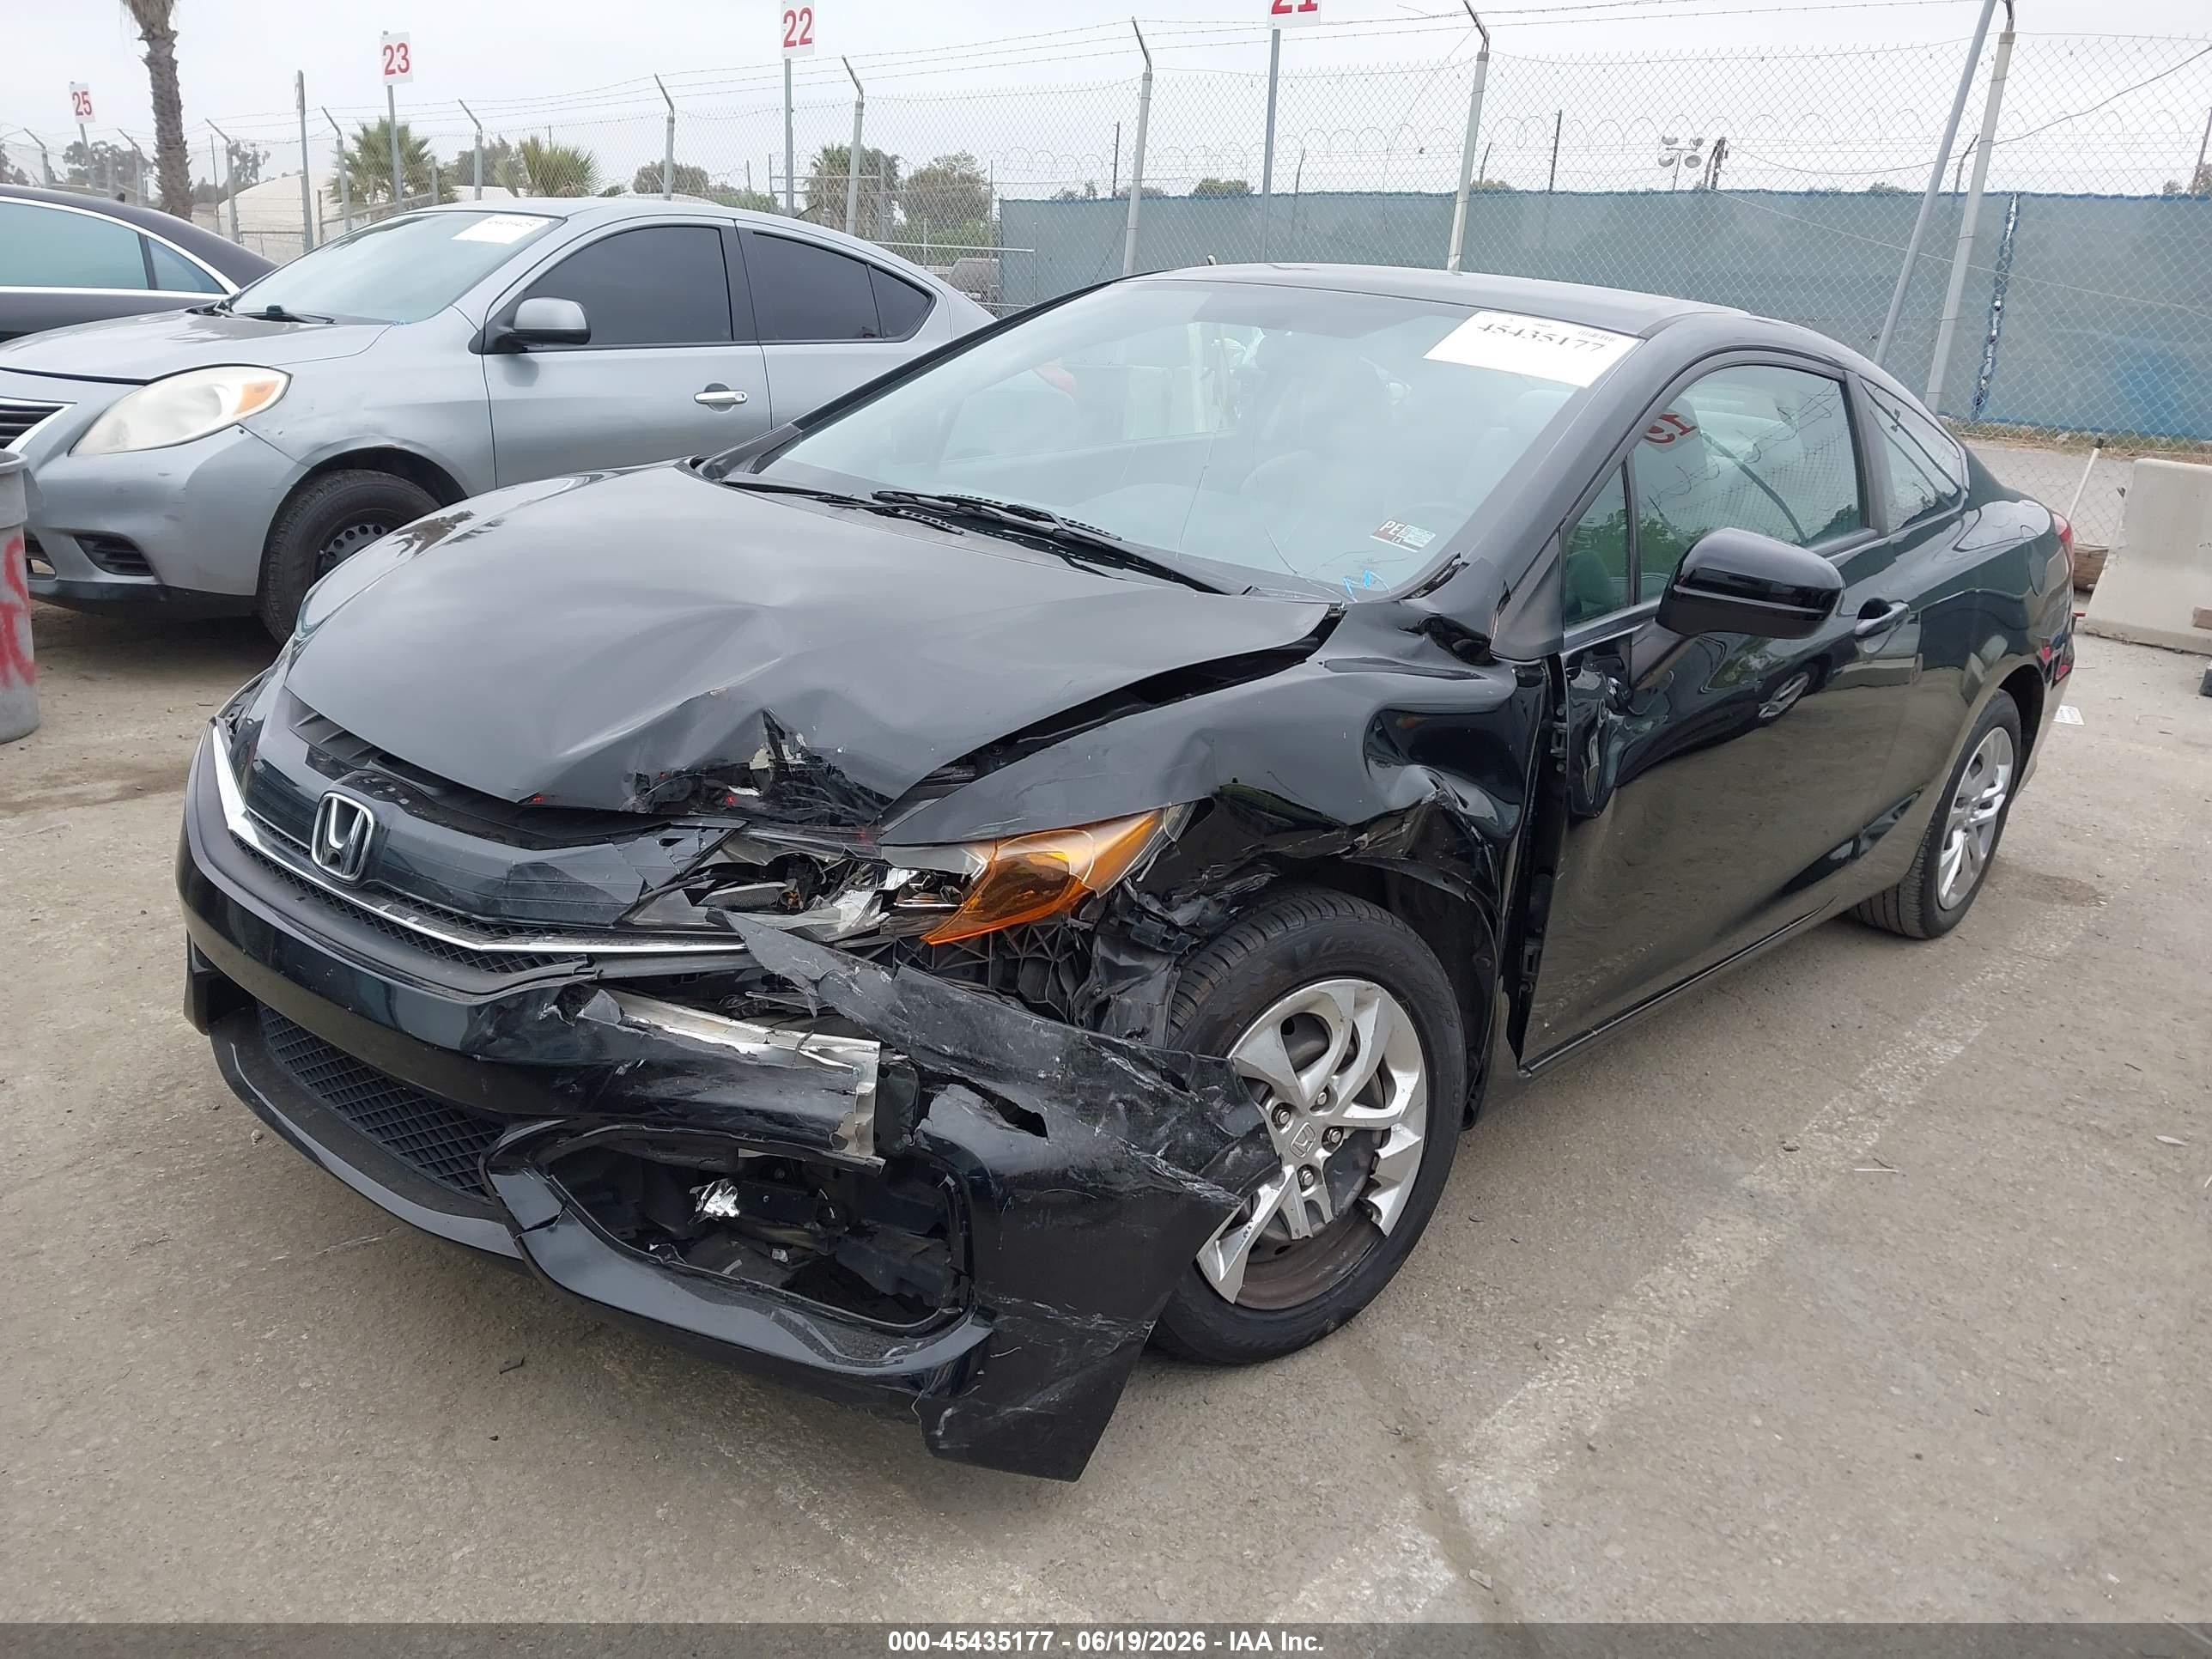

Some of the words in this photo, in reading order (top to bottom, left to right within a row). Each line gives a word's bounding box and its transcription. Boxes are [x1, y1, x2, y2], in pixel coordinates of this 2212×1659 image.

[783, 7, 812, 47] 22
[383, 43, 410, 75] 23
[72, 91, 92, 116] 25
[1477, 323, 1606, 352] 45435177
